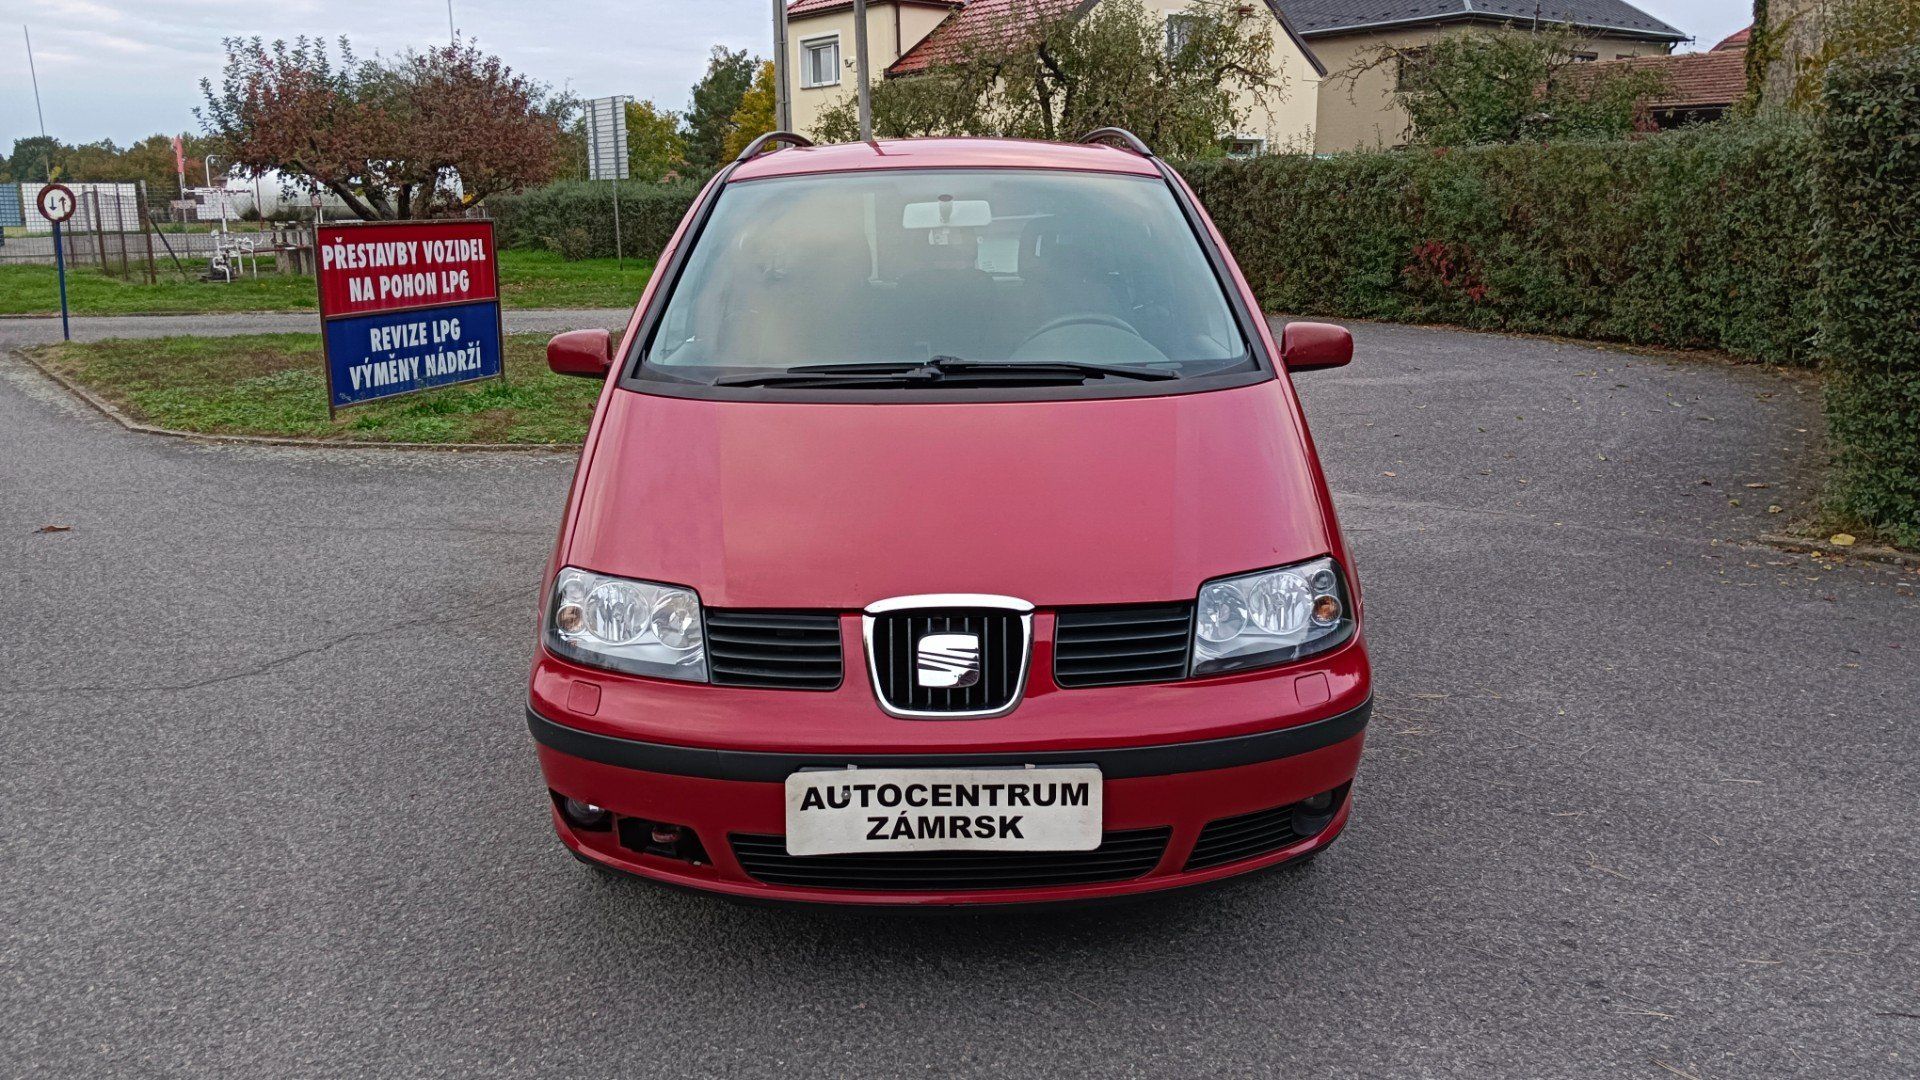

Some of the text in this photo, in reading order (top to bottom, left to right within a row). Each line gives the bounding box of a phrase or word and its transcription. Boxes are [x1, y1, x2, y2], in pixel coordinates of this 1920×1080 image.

[321, 237, 486, 270] PŘESTAVBY VOZIDEL
[349, 270, 470, 302] NA POHON LPG
[370, 318, 461, 352] REVIZE LPG
[349, 340, 482, 391] VÝMĚNY NÁDRŽÍ
[800, 783, 1089, 811] AUTOCENTRUM
[866, 811, 1024, 840] ZÁMRSK
